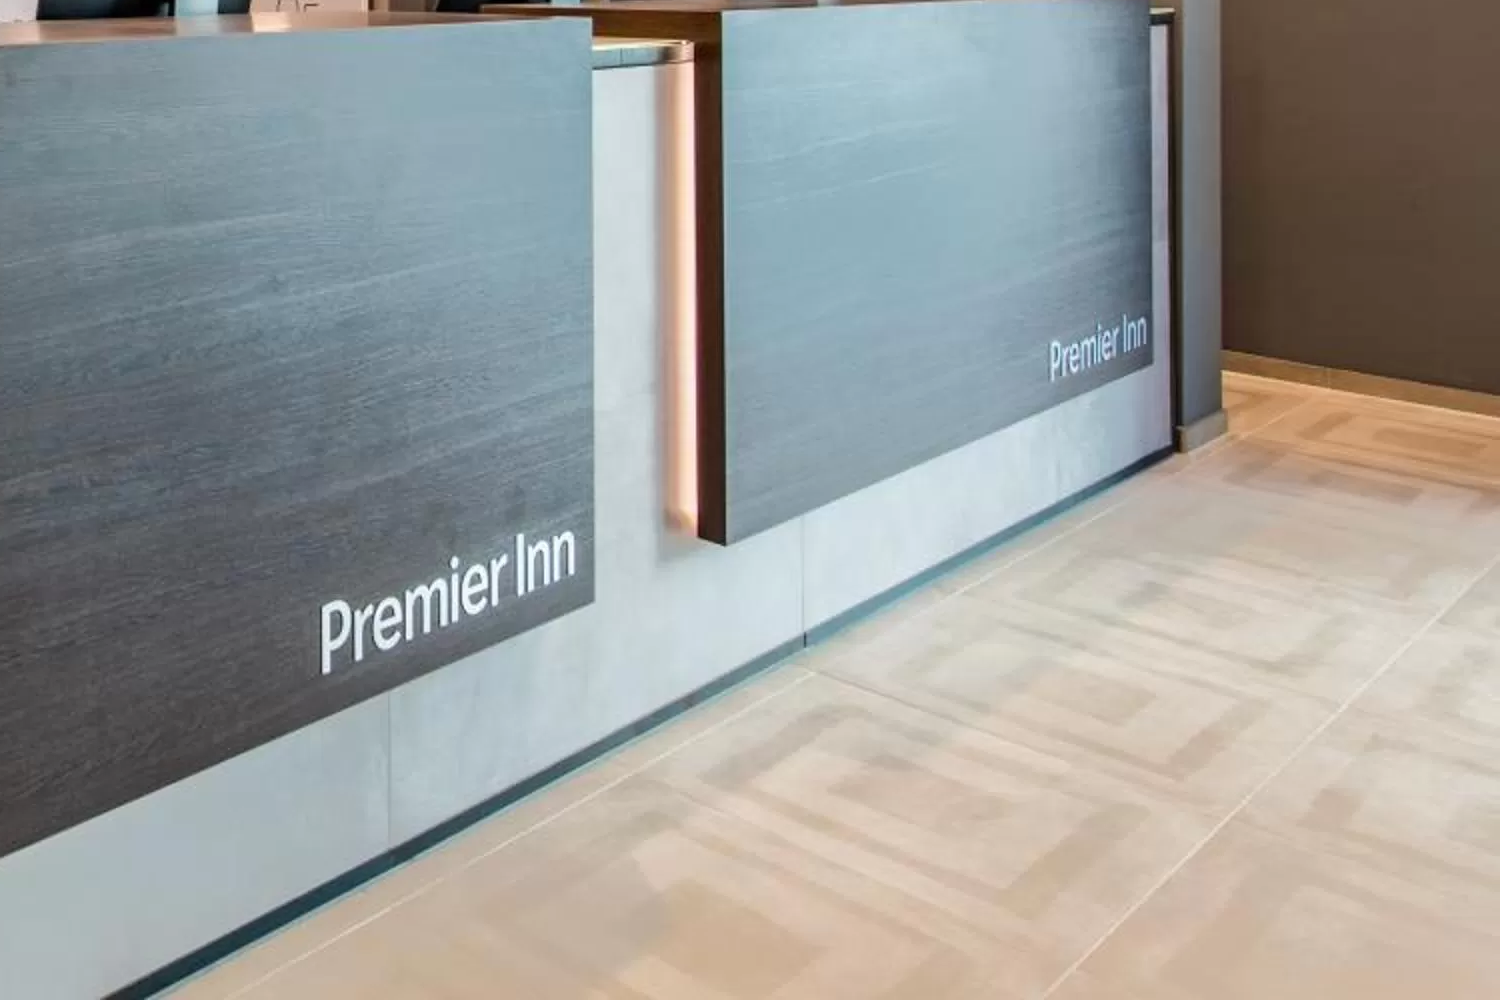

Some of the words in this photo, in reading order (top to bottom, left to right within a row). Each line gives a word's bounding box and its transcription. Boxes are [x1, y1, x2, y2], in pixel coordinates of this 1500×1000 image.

[1049, 323, 1120, 382] Premier
[1123, 313, 1147, 353] Inn
[320, 555, 508, 675] Premier
[516, 530, 575, 597] Inn
